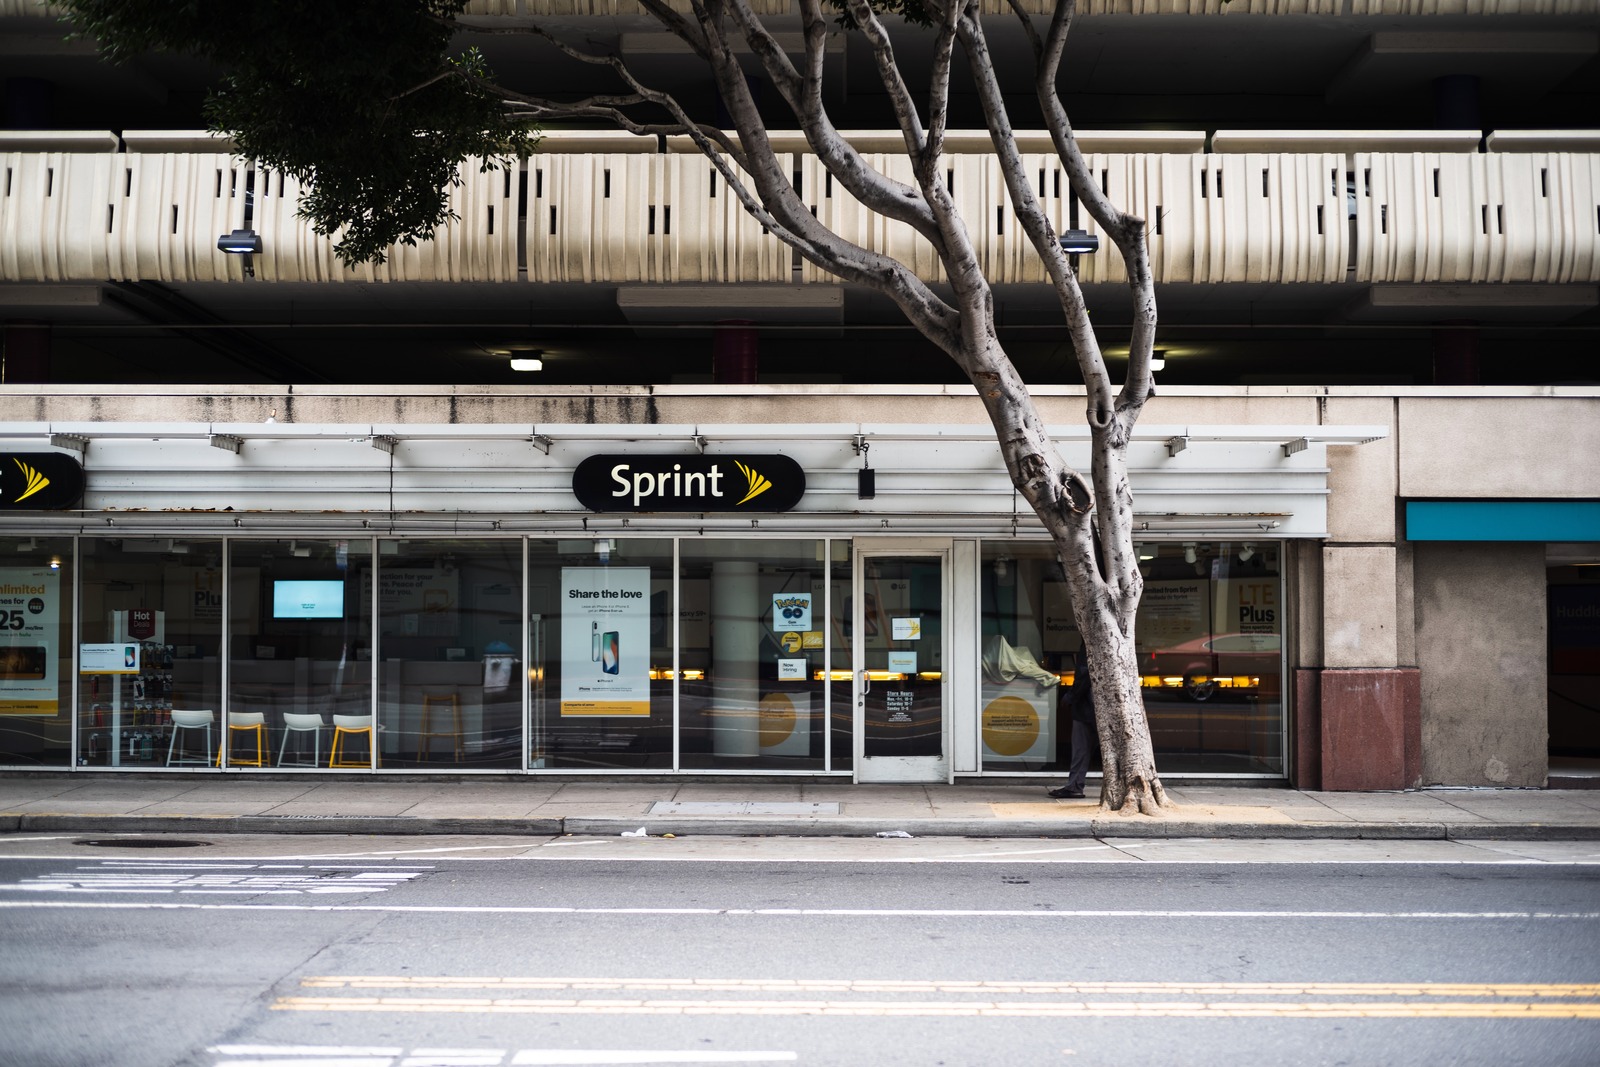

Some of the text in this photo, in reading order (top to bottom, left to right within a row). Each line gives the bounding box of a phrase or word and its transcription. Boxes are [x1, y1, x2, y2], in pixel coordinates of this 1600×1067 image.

[611, 464, 724, 506] Sprint
[195, 572, 222, 590] LT
[569, 589, 642, 598] Share the love
[1180, 586, 1198, 594] Sprint
[1240, 585, 1274, 605] LTE
[195, 591, 223, 605] Plu
[134, 611, 150, 620] Hot
[1240, 606, 1275, 622] Plus
